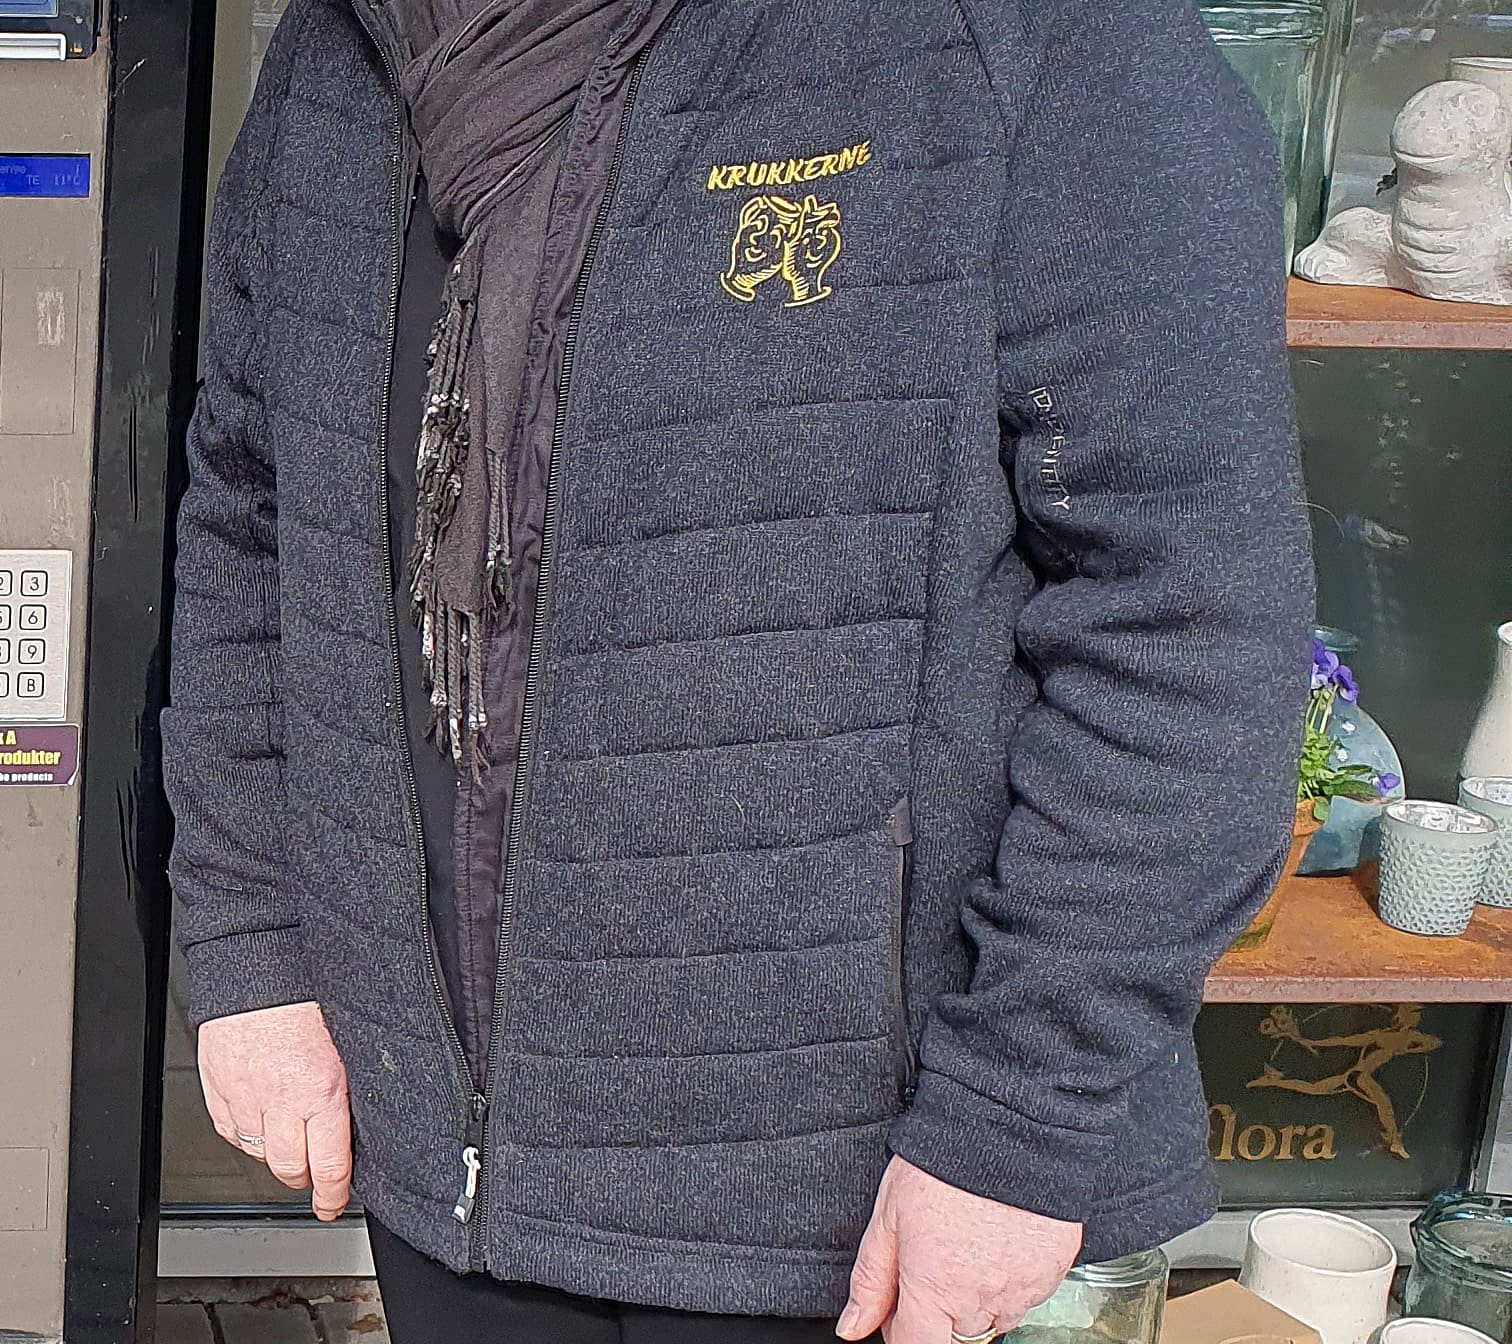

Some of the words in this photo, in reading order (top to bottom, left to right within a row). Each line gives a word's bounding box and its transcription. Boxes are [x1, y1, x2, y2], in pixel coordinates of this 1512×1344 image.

[707, 140, 872, 190] KRUKKERNE
[29, 575, 40, 591] 3
[27, 609, 39, 625] 6
[27, 644, 38, 659] 9
[26, 678, 36, 693] B
[5, 730, 17, 745] A
[11, 772, 54, 783] products
[1209, 1104, 1337, 1161] lora
